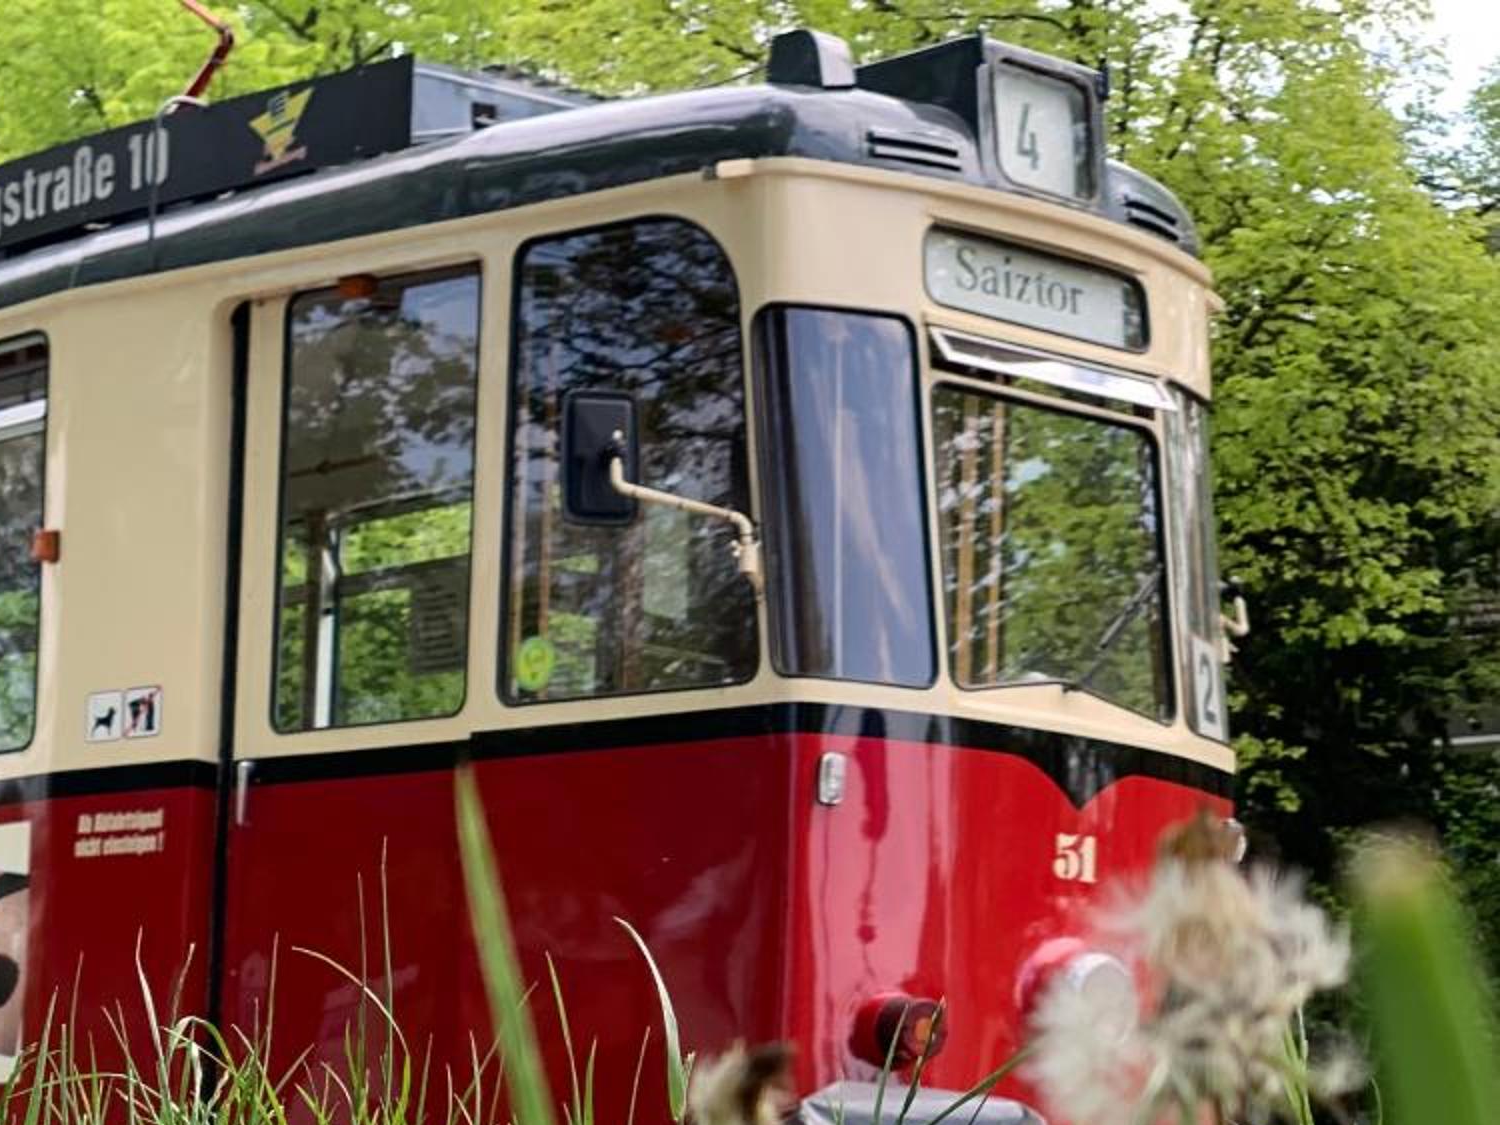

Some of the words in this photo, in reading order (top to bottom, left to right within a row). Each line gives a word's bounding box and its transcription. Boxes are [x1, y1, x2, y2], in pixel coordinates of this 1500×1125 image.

[129, 128, 169, 190] 10
[1017, 102, 1039, 170] 4
[1052, 833, 1098, 884] 51
